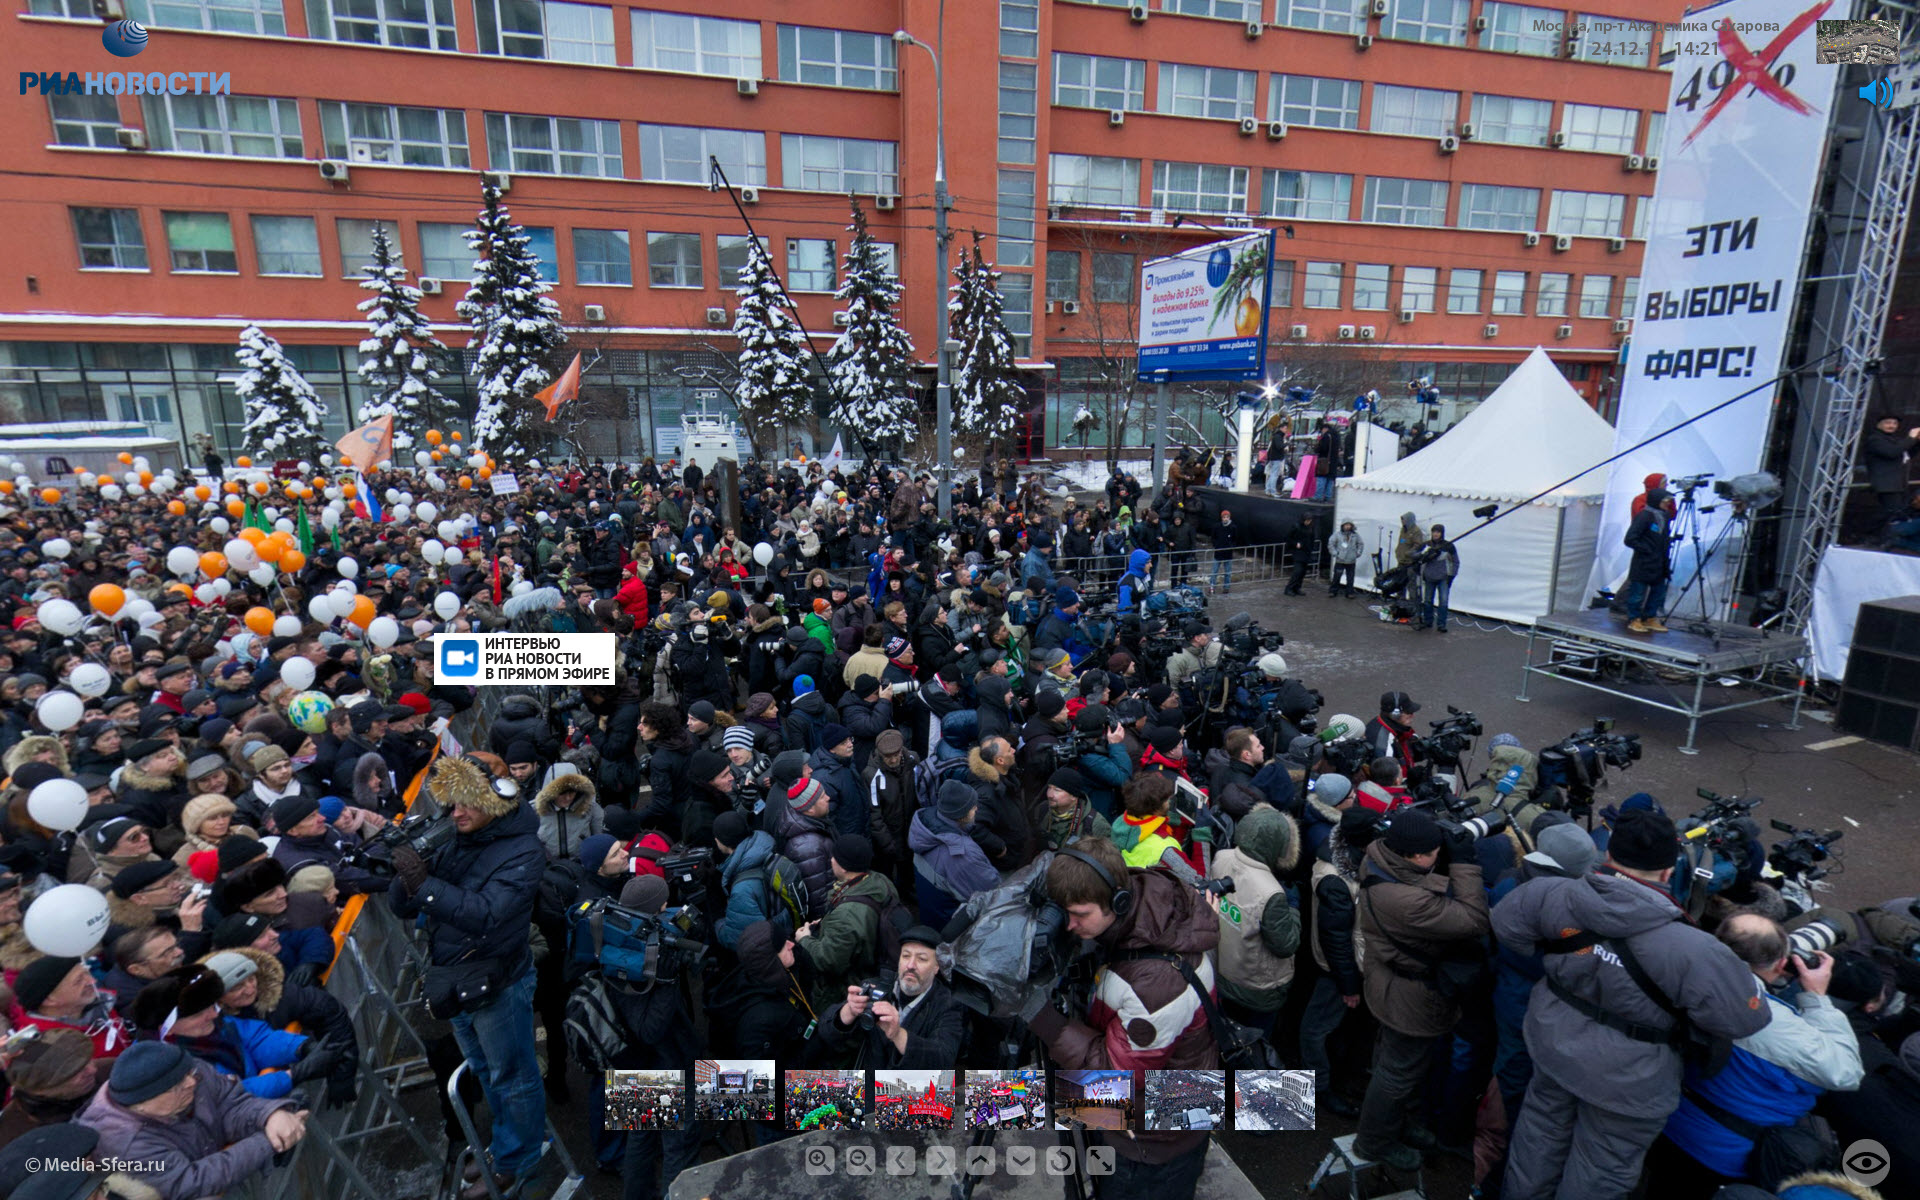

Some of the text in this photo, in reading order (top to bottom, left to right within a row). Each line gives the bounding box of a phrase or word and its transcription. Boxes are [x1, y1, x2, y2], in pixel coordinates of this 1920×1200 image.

[1683, 217, 1759, 258] ЭТИ
[1644, 279, 1782, 322] ВЫБОРЫ
[1644, 346, 1757, 380] ФАРС!
